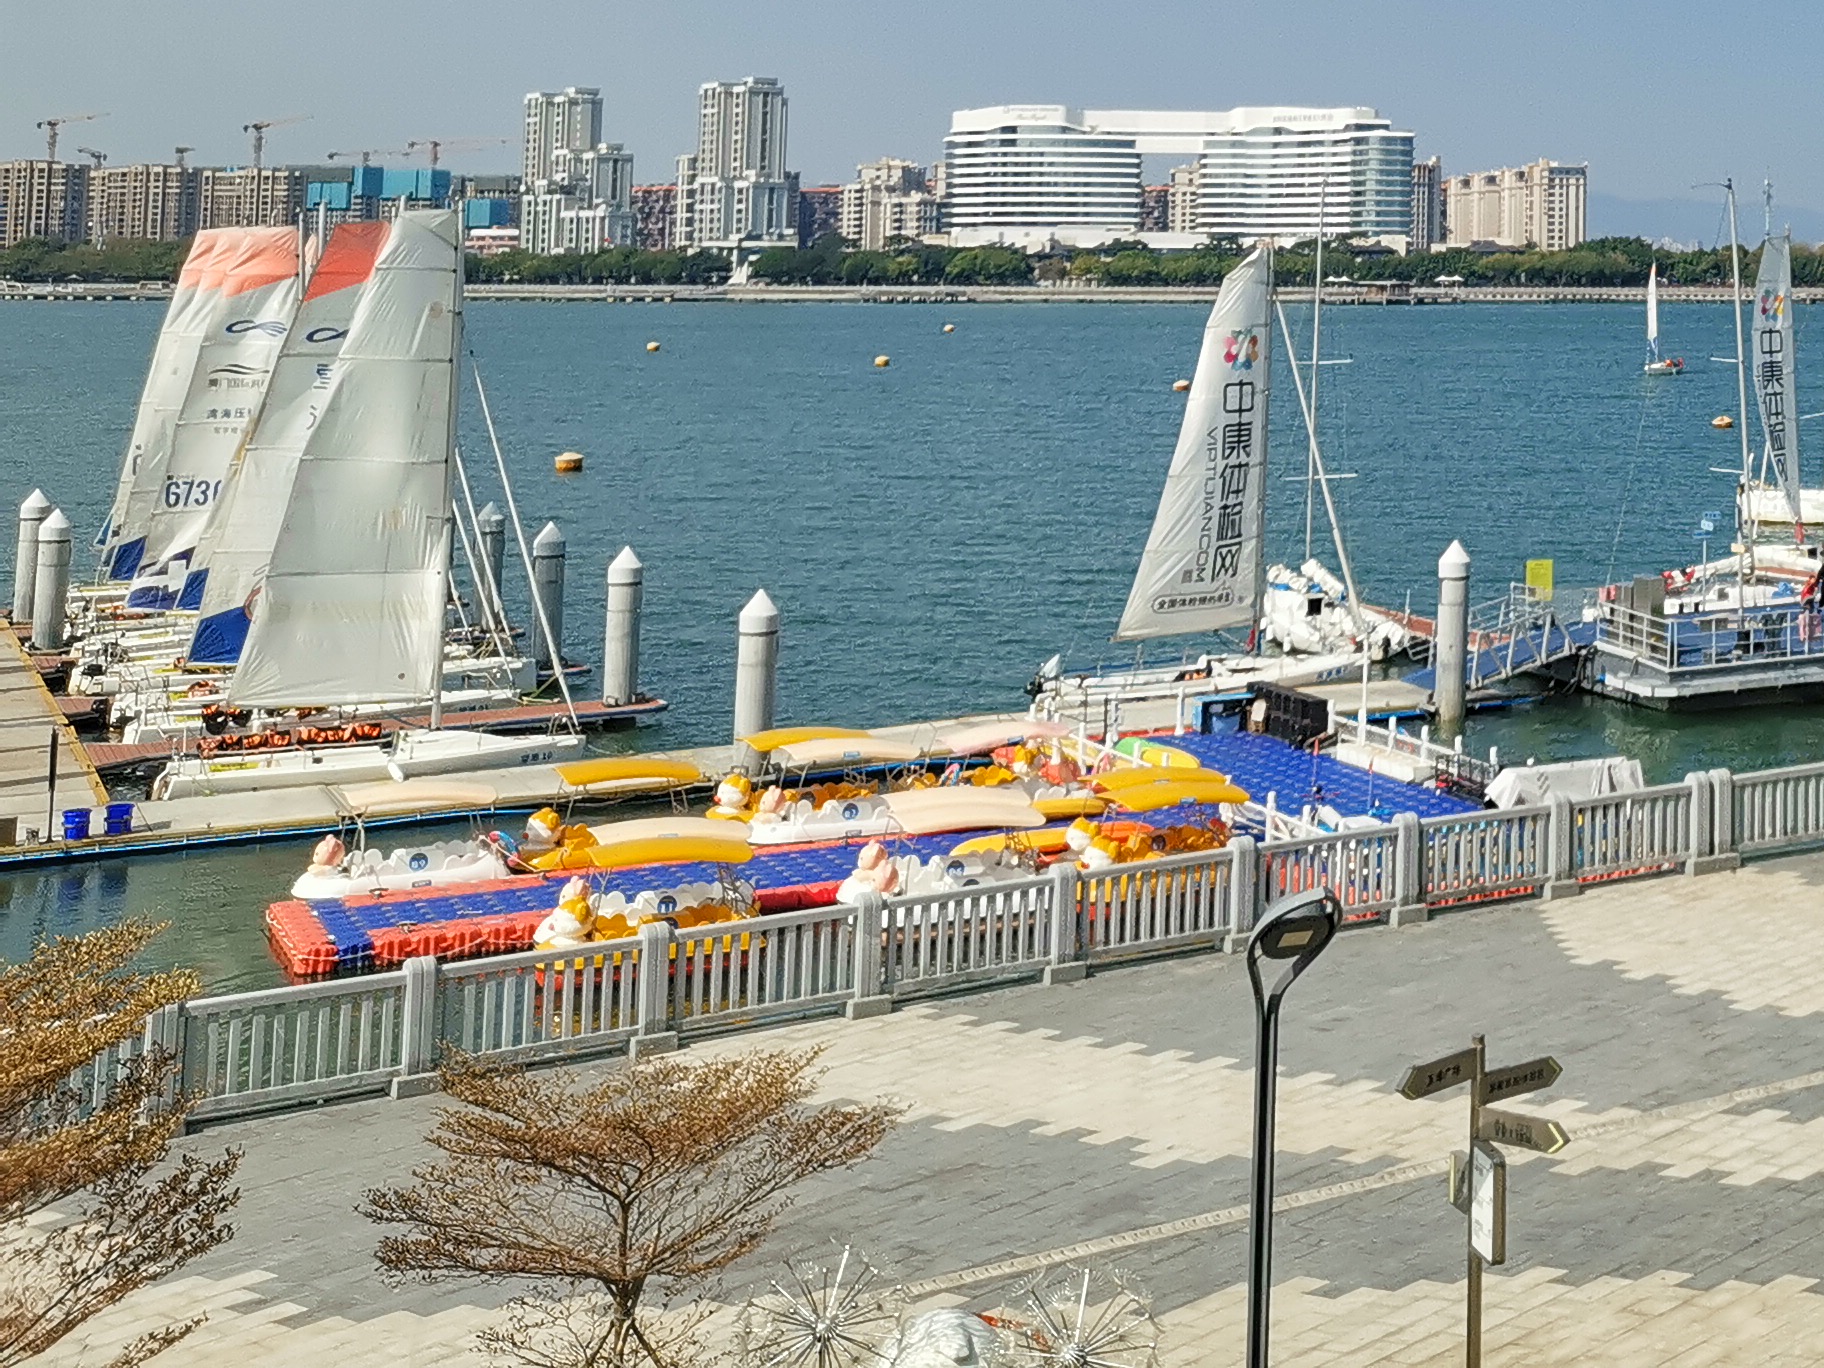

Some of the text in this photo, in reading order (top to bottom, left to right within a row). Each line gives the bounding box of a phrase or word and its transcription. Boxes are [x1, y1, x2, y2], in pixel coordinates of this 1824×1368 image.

[1210, 379, 1255, 583] 中康体检网
